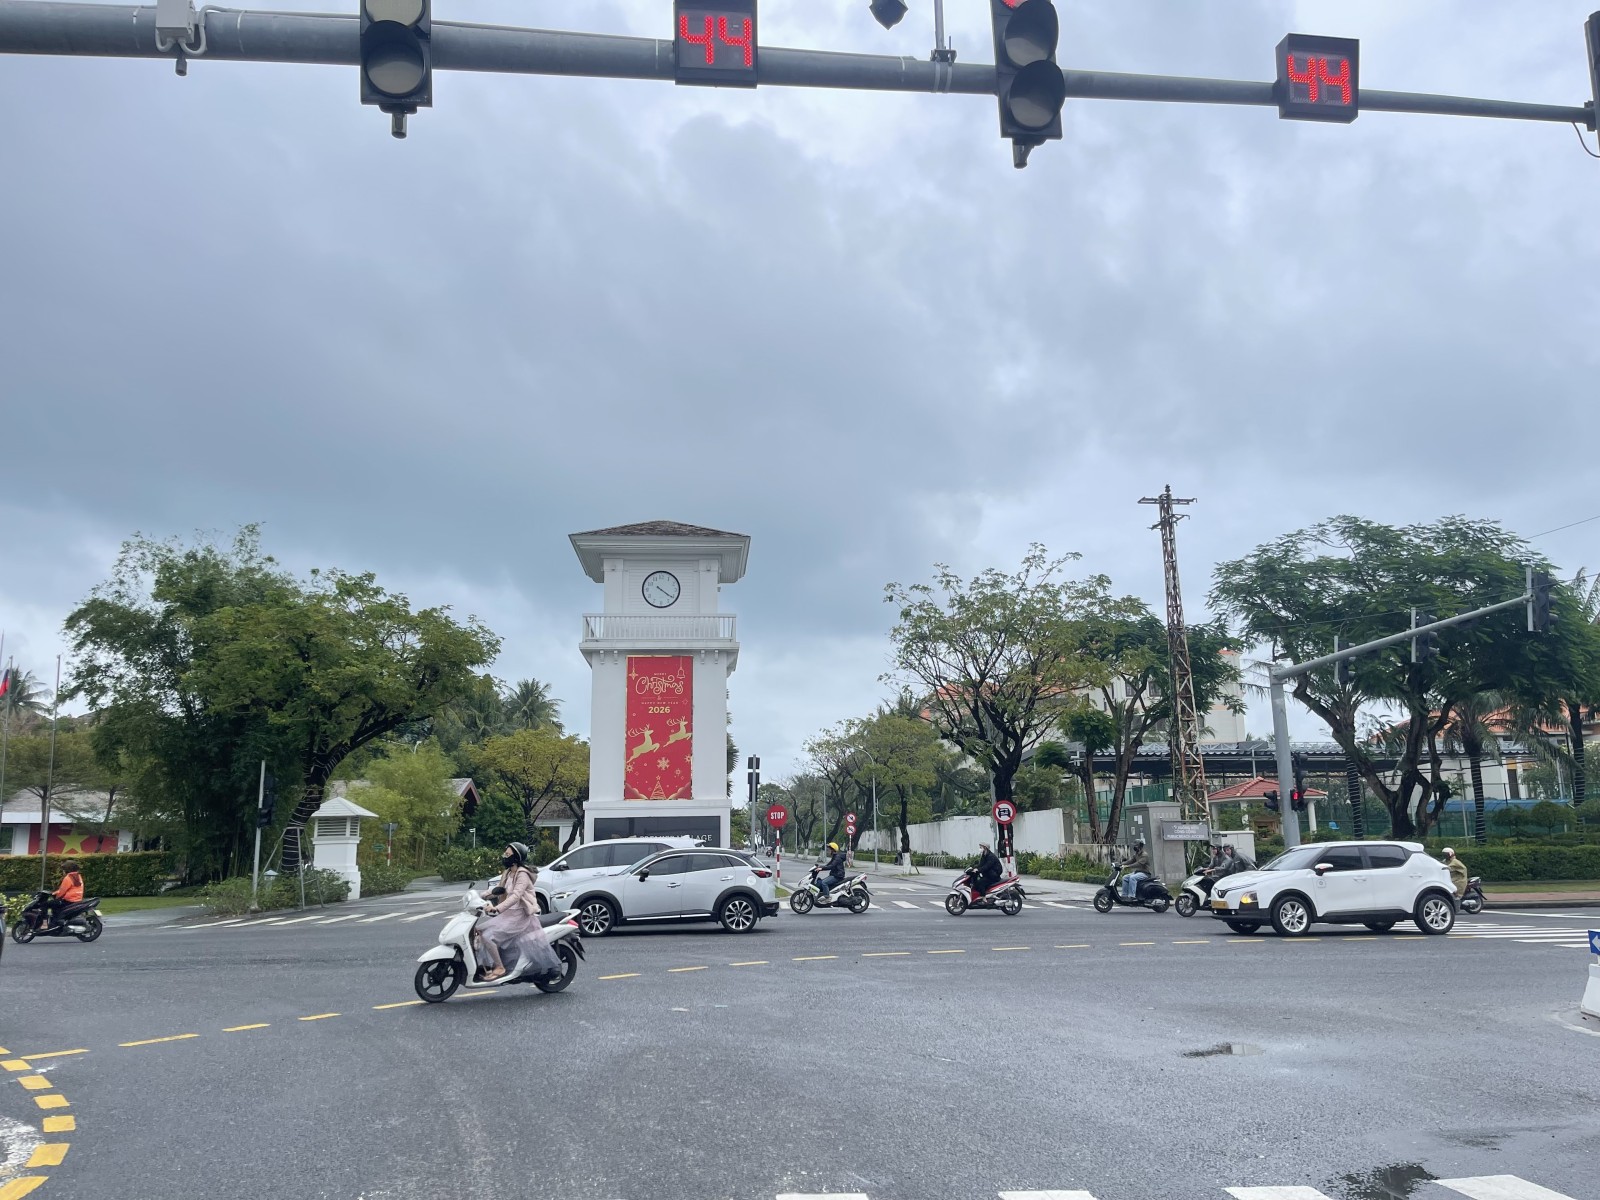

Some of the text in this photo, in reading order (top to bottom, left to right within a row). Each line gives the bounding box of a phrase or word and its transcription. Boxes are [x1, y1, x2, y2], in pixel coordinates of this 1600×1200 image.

[680, 15, 752, 67] 44
[1287, 55, 1351, 104] 44
[635, 675, 684, 695] Christmas
[648, 706, 671, 714] 2026
[770, 811, 785, 820] STOP
